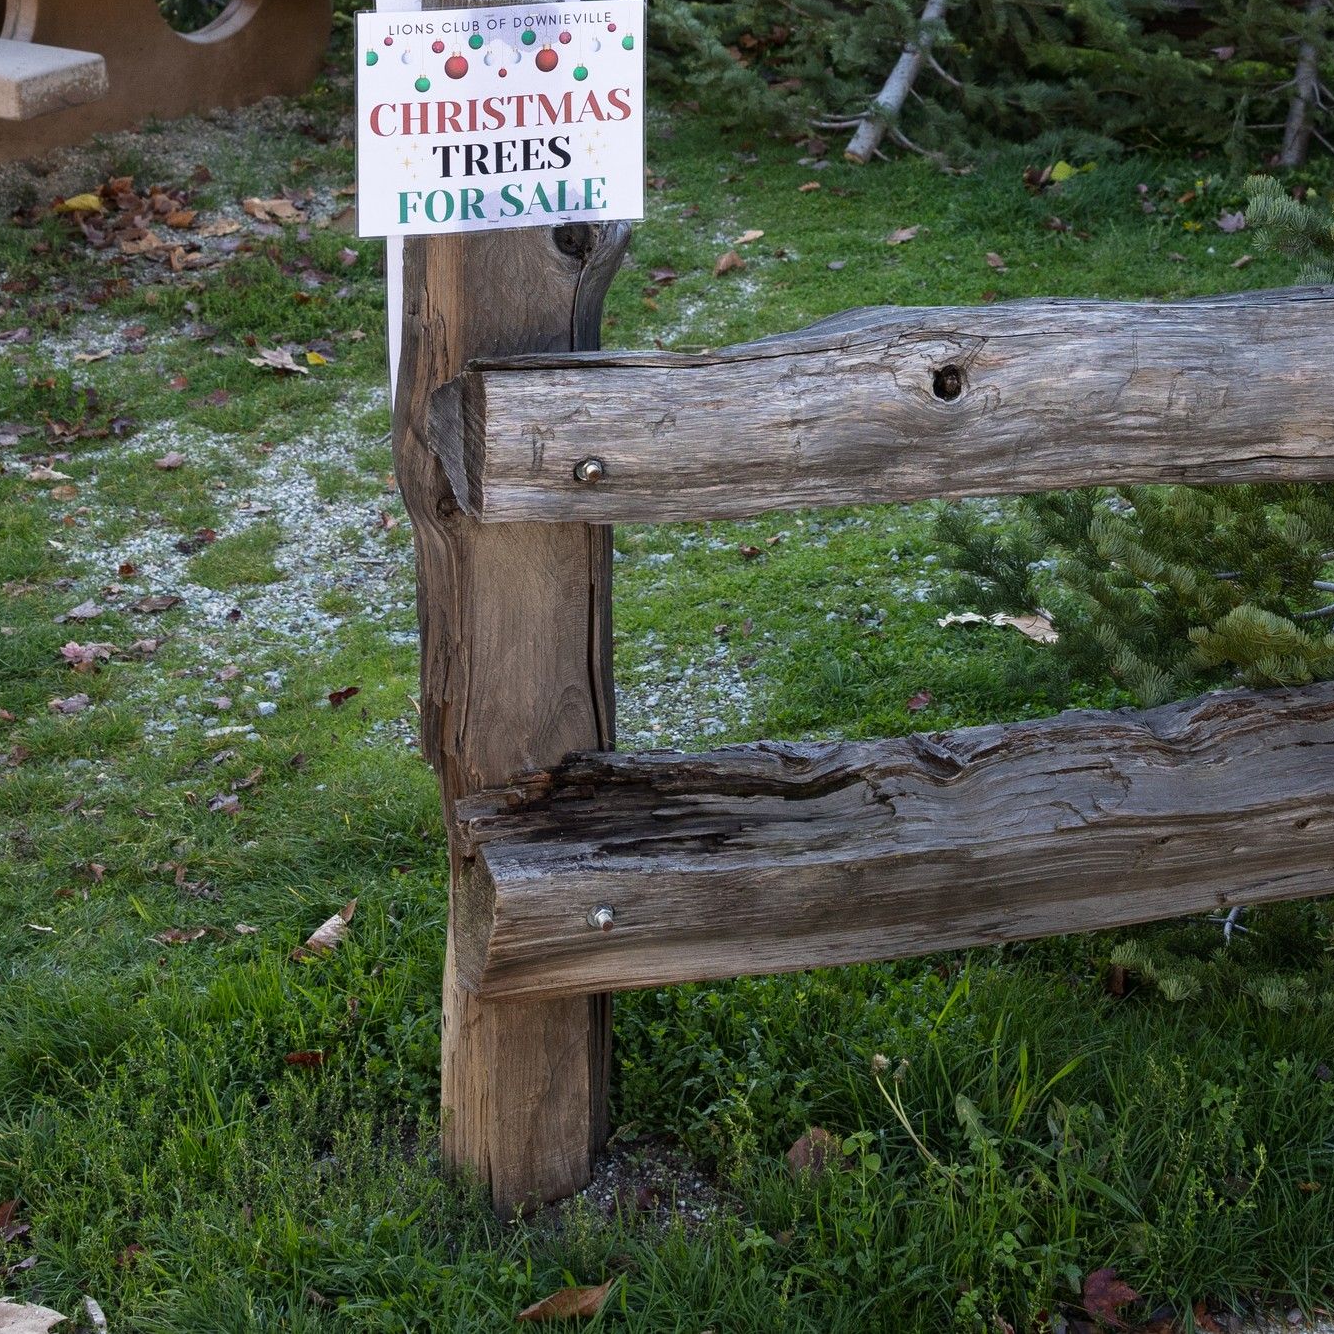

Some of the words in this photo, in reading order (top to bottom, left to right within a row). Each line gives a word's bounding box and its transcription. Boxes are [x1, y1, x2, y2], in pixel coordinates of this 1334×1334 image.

[388, 22, 434, 36] LIONS
[441, 20, 480, 34] CLUB
[486, 18, 506, 30] OF
[513, 11, 612, 28] DOWNIEVILLE
[369, 87, 632, 137] CHRISTMAS
[432, 135, 572, 178] TREES
[397, 186, 487, 224] FOR
[500, 176, 607, 217] SALE
